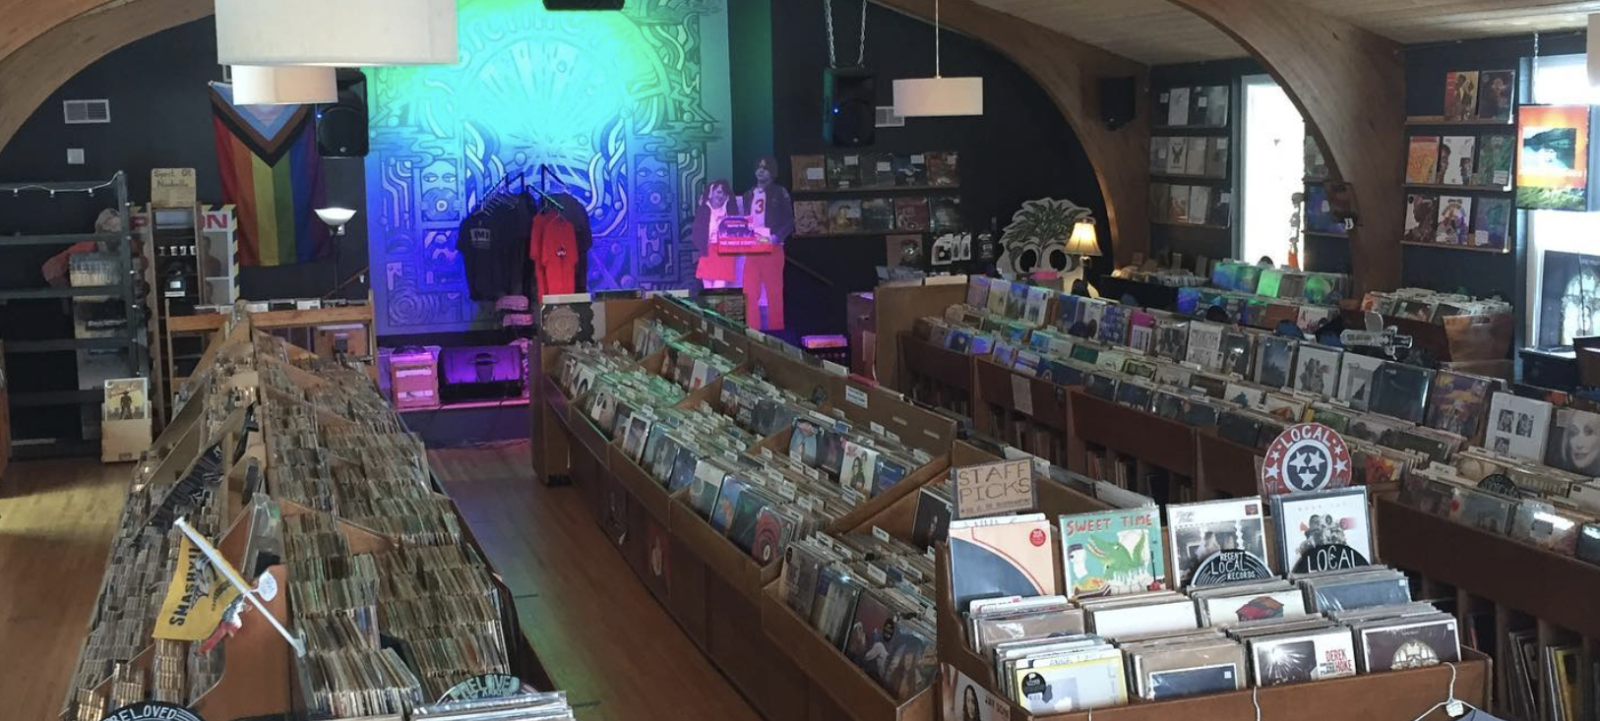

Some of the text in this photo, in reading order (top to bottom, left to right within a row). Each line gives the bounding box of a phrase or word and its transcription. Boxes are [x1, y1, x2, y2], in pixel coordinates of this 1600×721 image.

[1280, 425, 1331, 449] LOCAL
[958, 461, 1029, 486] STAFF
[959, 477, 1030, 504] PICKS
[1067, 513, 1152, 536] SWEET TIME
[1210, 558, 1250, 575] LOCAL
[1220, 551, 1244, 561] RECENT
[1307, 545, 1356, 573] LOCAL
[1227, 570, 1256, 581] RECORDS
[1325, 648, 1347, 662] DEREK
